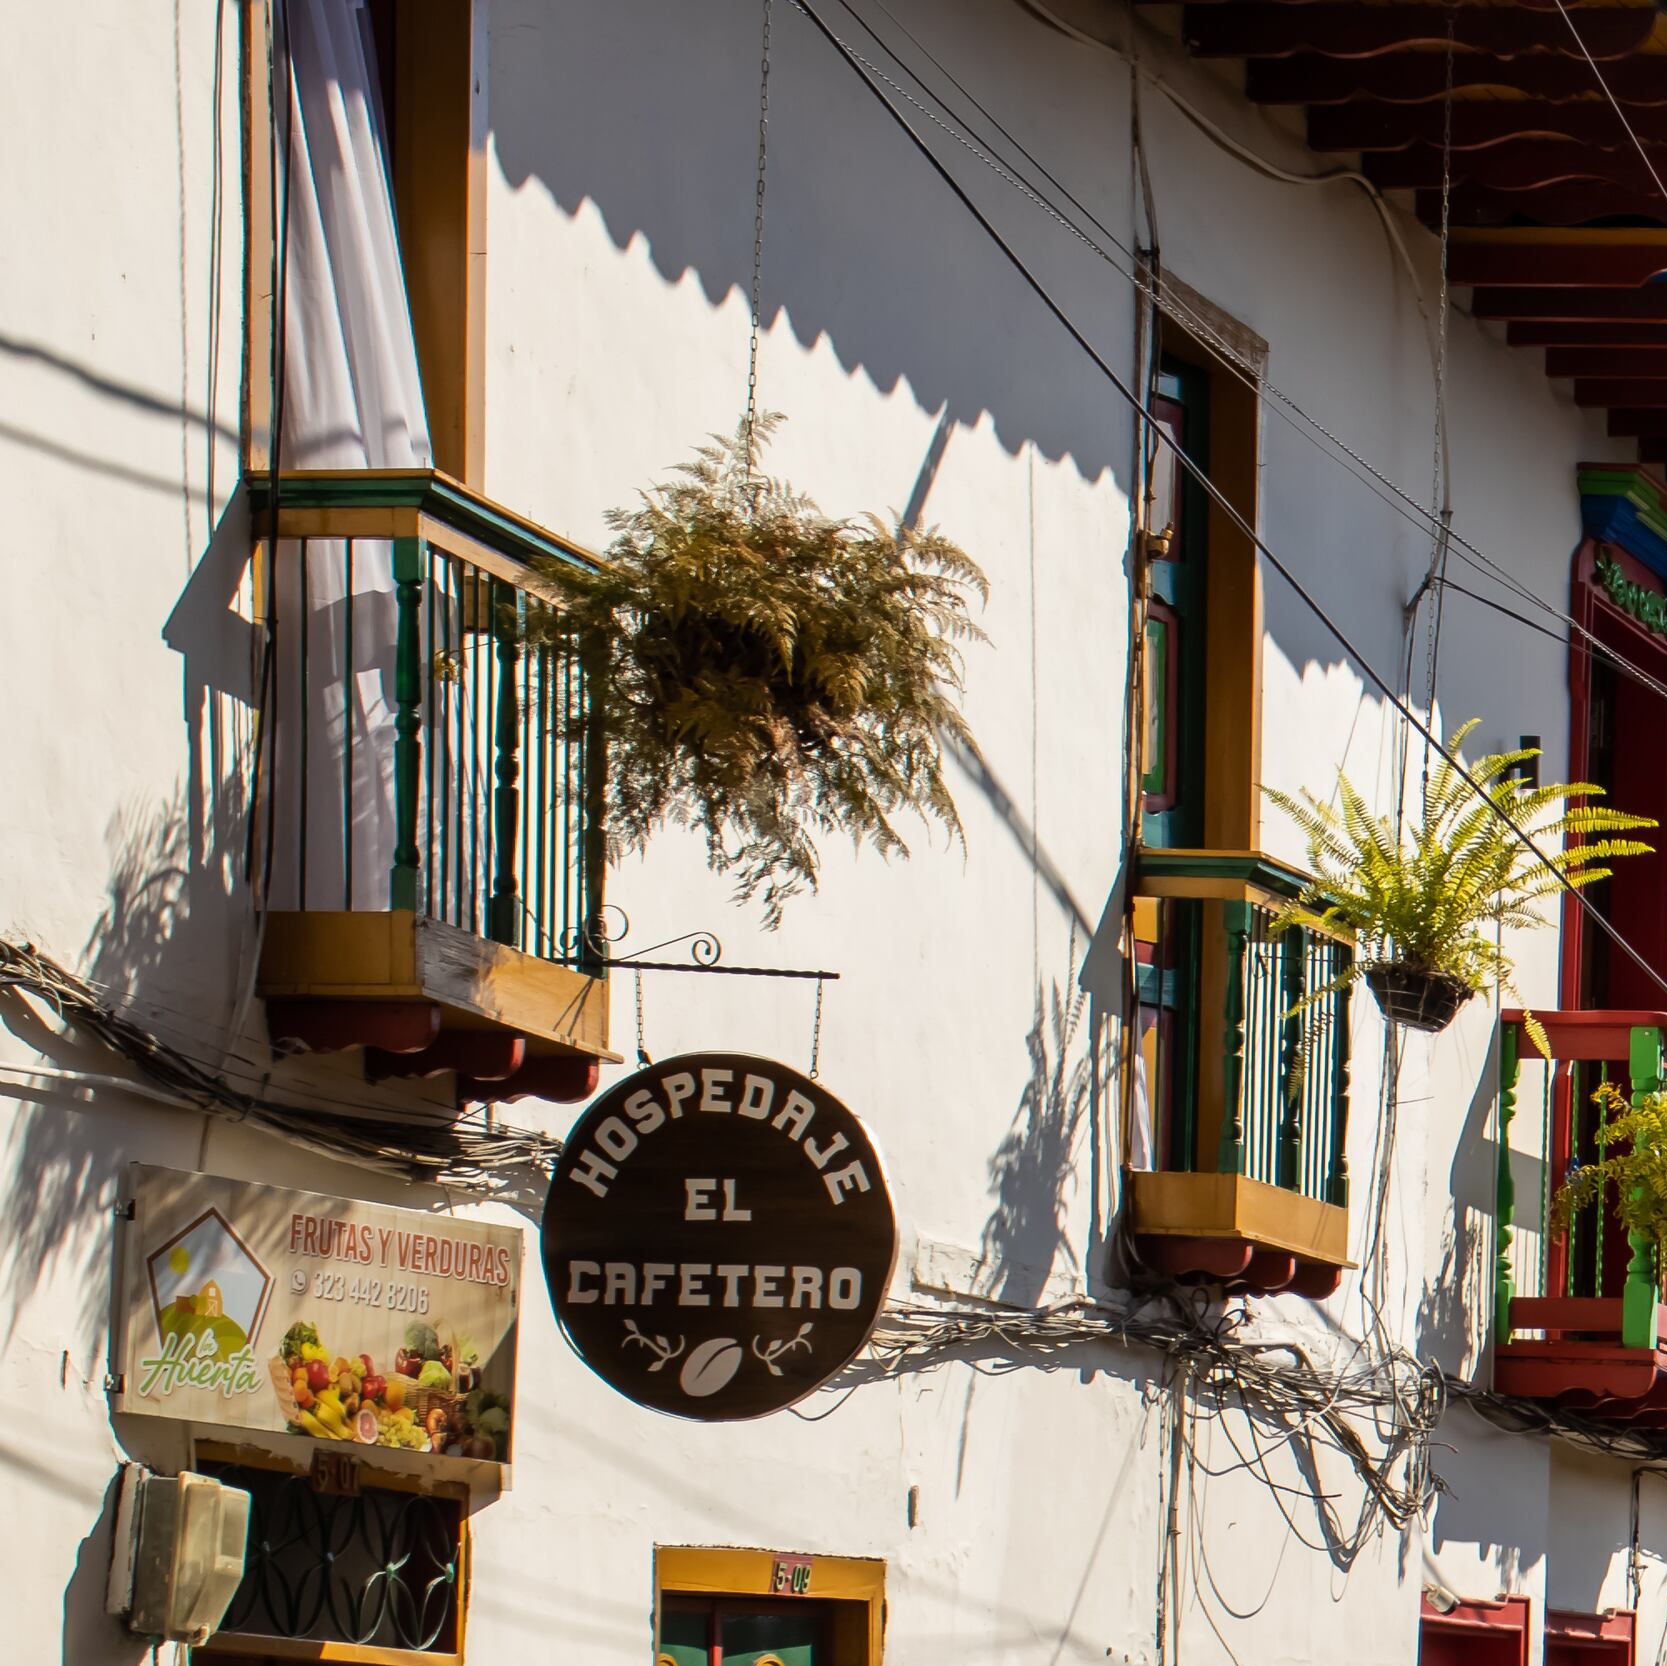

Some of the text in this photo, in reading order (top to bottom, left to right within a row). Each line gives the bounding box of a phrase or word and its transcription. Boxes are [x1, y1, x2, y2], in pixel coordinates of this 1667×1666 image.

[568, 1068, 871, 1205] HOSPEDAJE
[684, 1178, 752, 1221] EL
[290, 1214, 511, 1287] FRUTAS Y VERDURAS
[314, 1272, 429, 1314] 323 442 8206
[567, 1260, 863, 1310] CAFETERO
[139, 1332, 264, 1397] Huerta
[195, 1328, 219, 1358] la
[774, 1562, 811, 1593] 5-09
